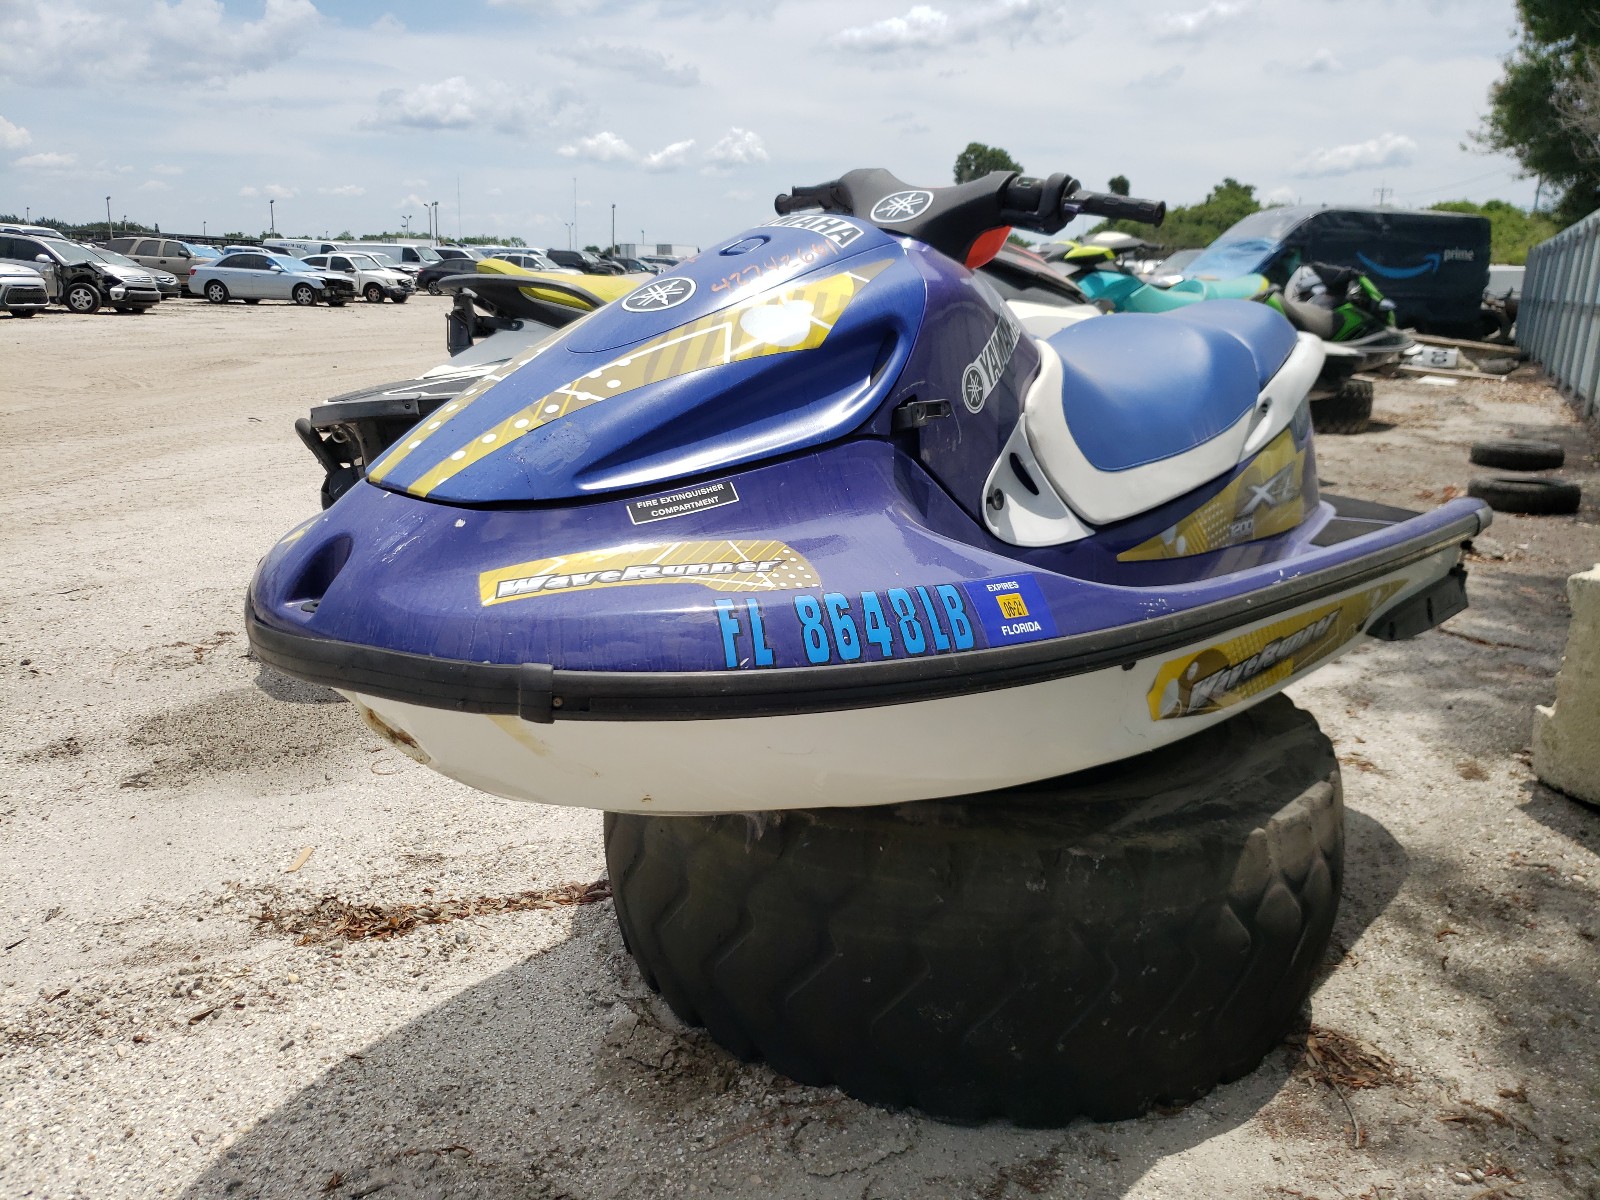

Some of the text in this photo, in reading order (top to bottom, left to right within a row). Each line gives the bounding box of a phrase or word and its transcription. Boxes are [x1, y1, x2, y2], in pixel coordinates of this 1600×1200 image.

[1443, 246, 1475, 262] prime
[636, 483, 725, 509] FIRE EXTINGUISHER
[651, 496, 719, 517] COMPARTMENT
[495, 559, 787, 598] WaveRunner
[986, 581, 1020, 592] EXPIRES
[714, 584, 974, 668] FL 8648LB
[1001, 621, 1042, 636] FLORIDA
